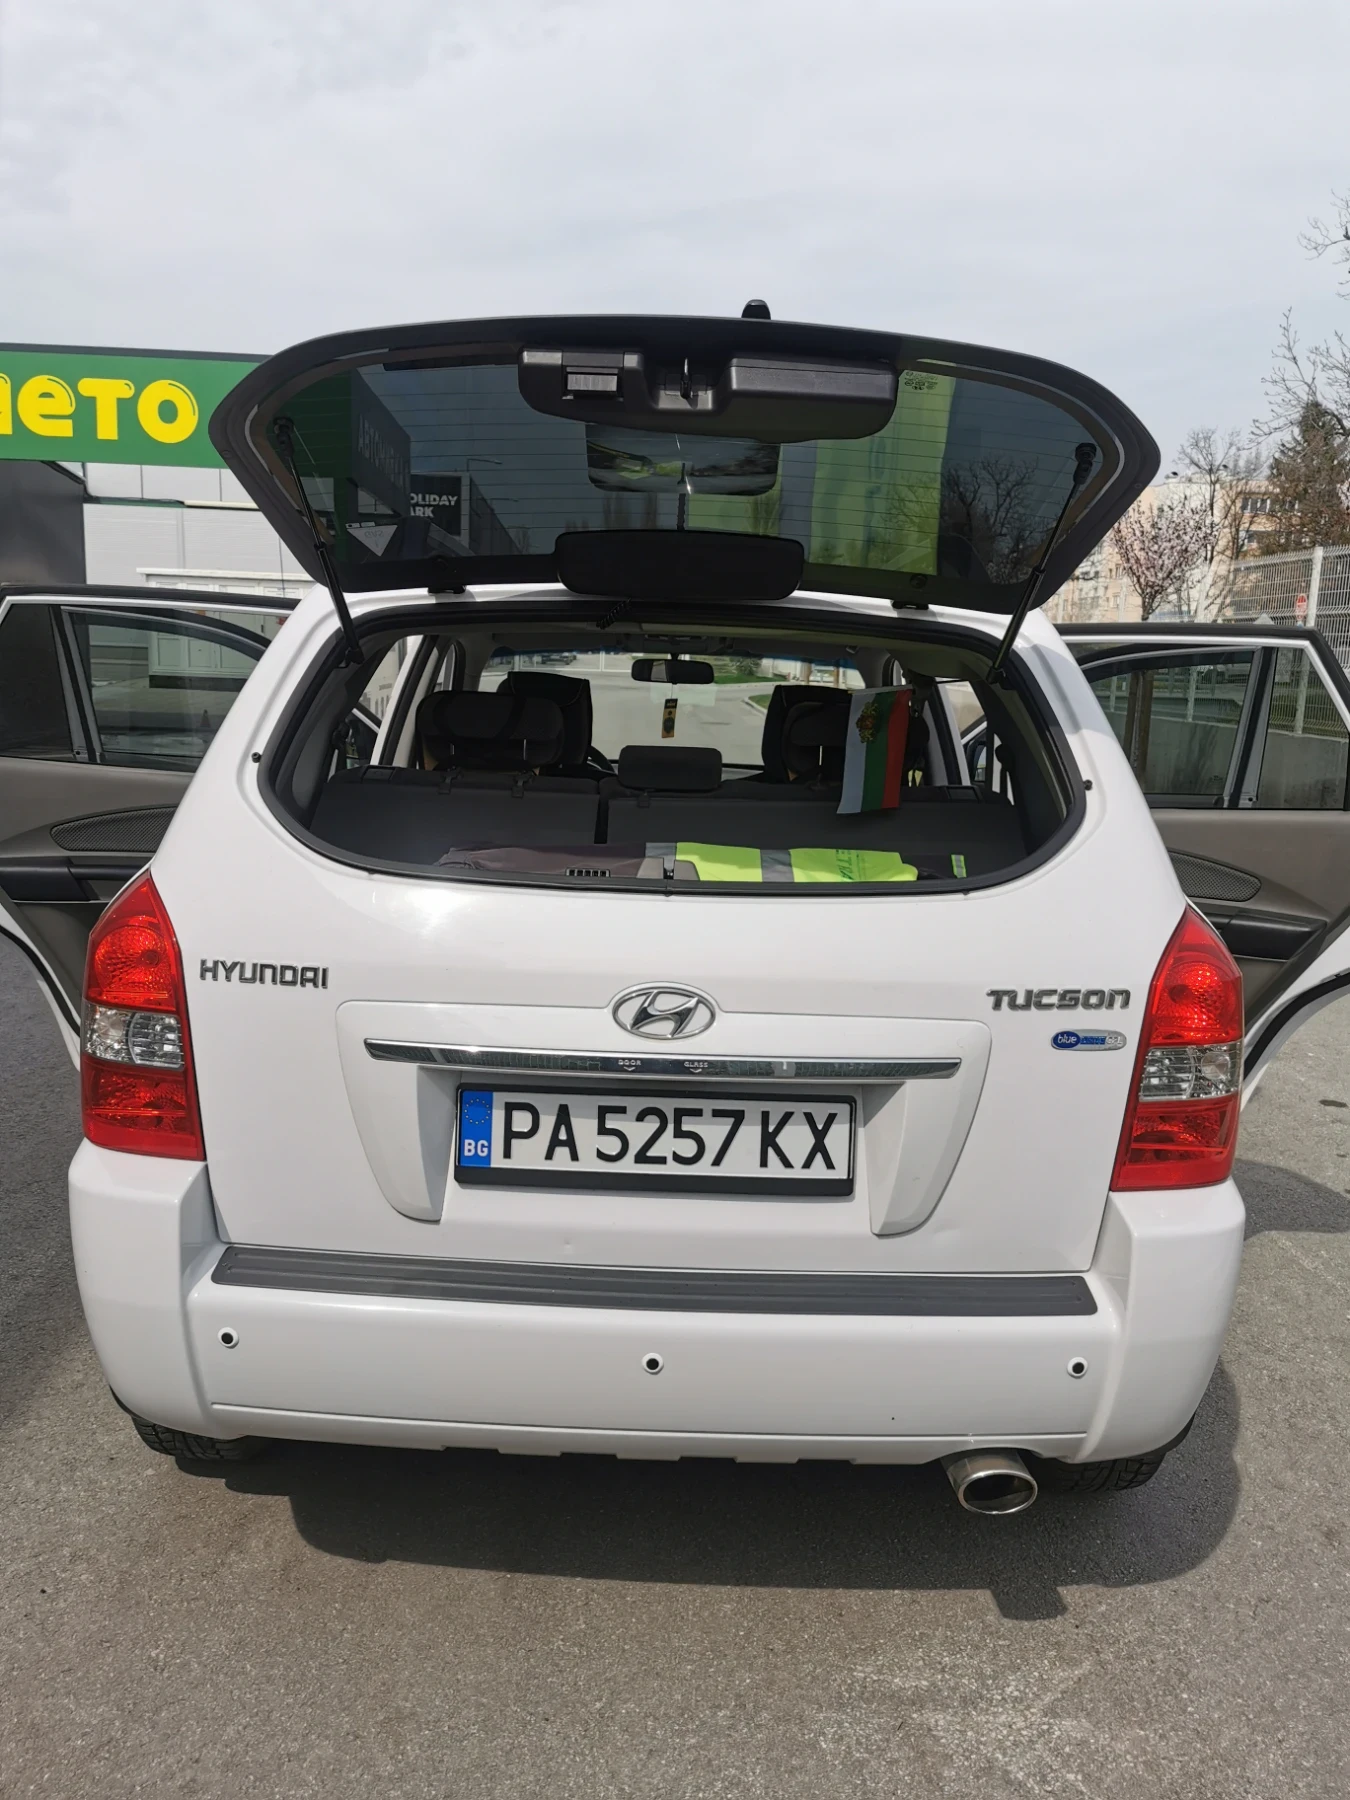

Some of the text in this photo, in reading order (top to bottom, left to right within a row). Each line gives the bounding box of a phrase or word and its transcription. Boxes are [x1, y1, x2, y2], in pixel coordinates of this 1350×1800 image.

[410, 493, 458, 506] OLIDAY
[199, 959, 329, 989] HYUNDAI
[986, 988, 1131, 1011] TUCSON
[1057, 1033, 1078, 1044] blue
[503, 1101, 839, 1170] PA 5257 KX
[463, 1139, 489, 1157] BG
